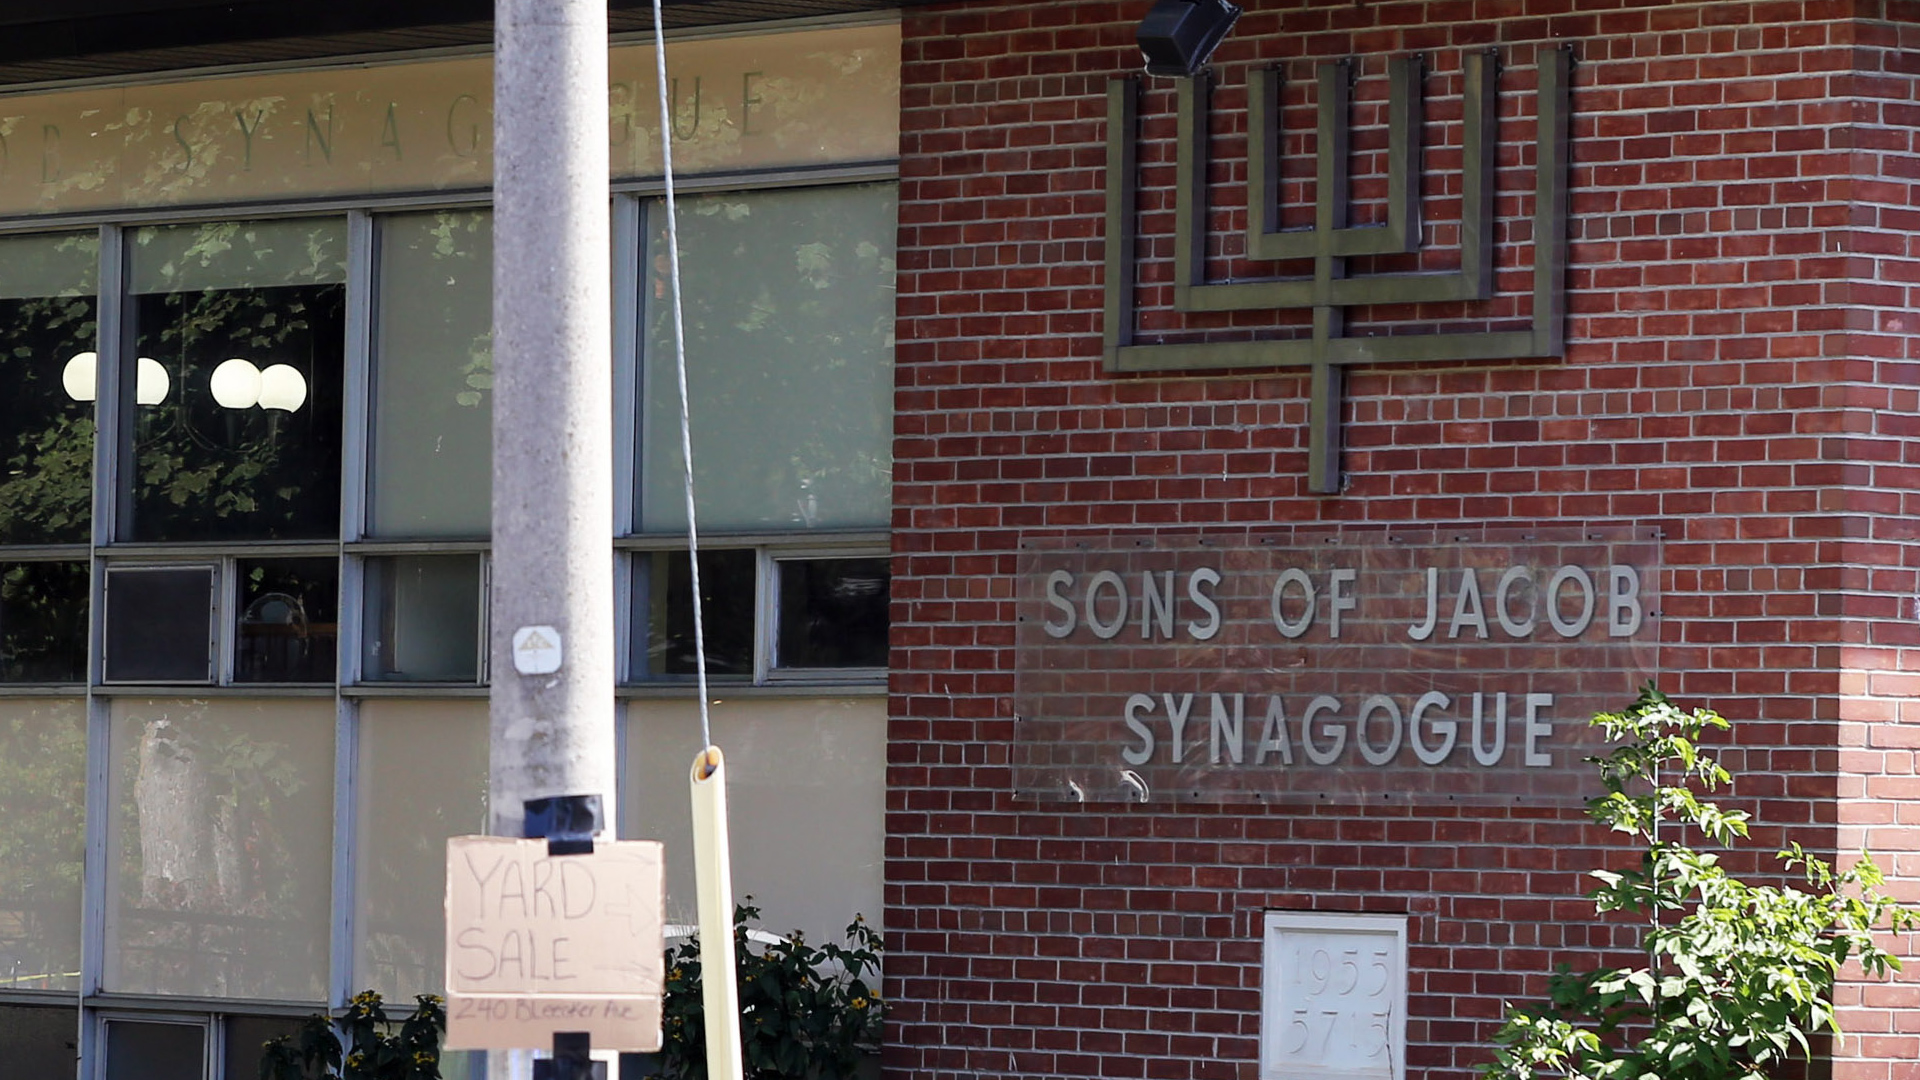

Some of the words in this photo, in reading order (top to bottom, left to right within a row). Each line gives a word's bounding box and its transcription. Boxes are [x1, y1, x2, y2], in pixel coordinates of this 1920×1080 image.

[172, 70, 764, 175] SYNAGGUE
[1043, 568, 1222, 640] SONS
[1271, 567, 1357, 639] OF
[1407, 564, 1642, 640] JACOB
[1121, 690, 1554, 767] SYNAGOGUE
[464, 852, 597, 920] YARD
[456, 927, 577, 981] SALE
[1292, 949, 1389, 996] 1955
[454, 998, 508, 1022] 240
